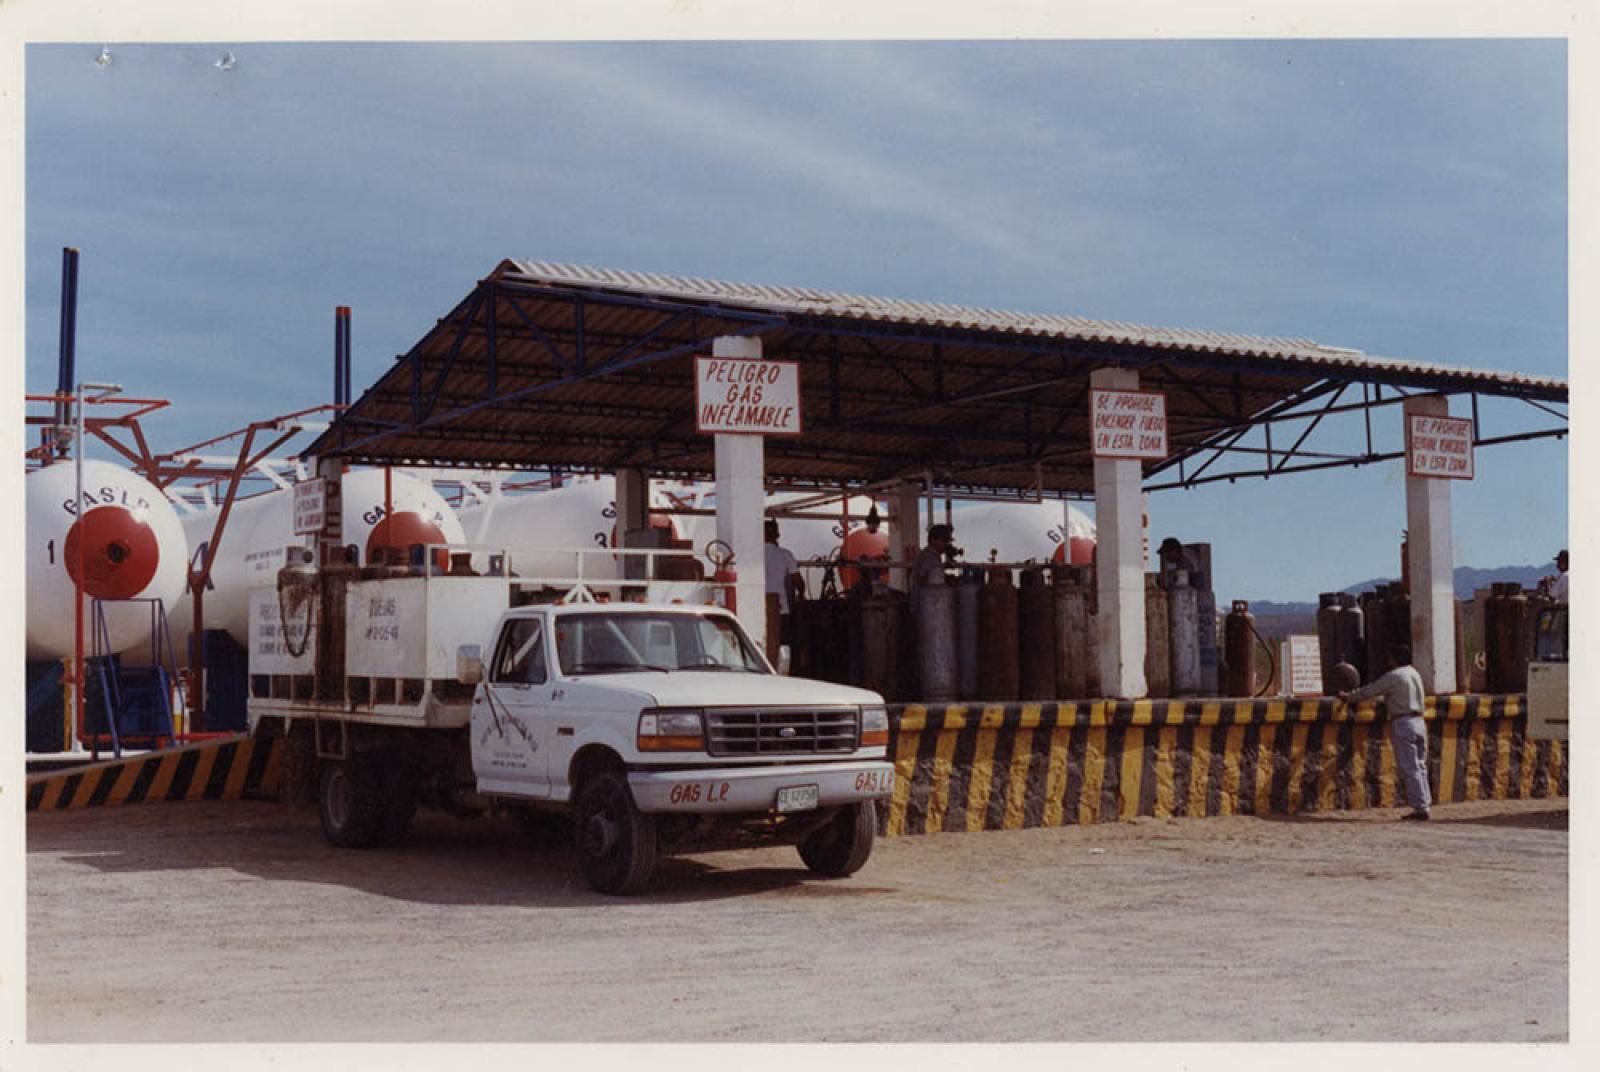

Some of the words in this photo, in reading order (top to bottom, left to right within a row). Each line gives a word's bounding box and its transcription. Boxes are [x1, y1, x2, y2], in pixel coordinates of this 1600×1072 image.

[706, 361, 781, 385] PELIGRO
[726, 384, 763, 405] GAS
[702, 403, 794, 428] INFLAMABLE
[1097, 433, 1110, 448] EN
[63, 487, 115, 515] GAS
[47, 539, 55, 565] 1
[855, 772, 877, 791] GAS
[671, 783, 701, 804] GAS
